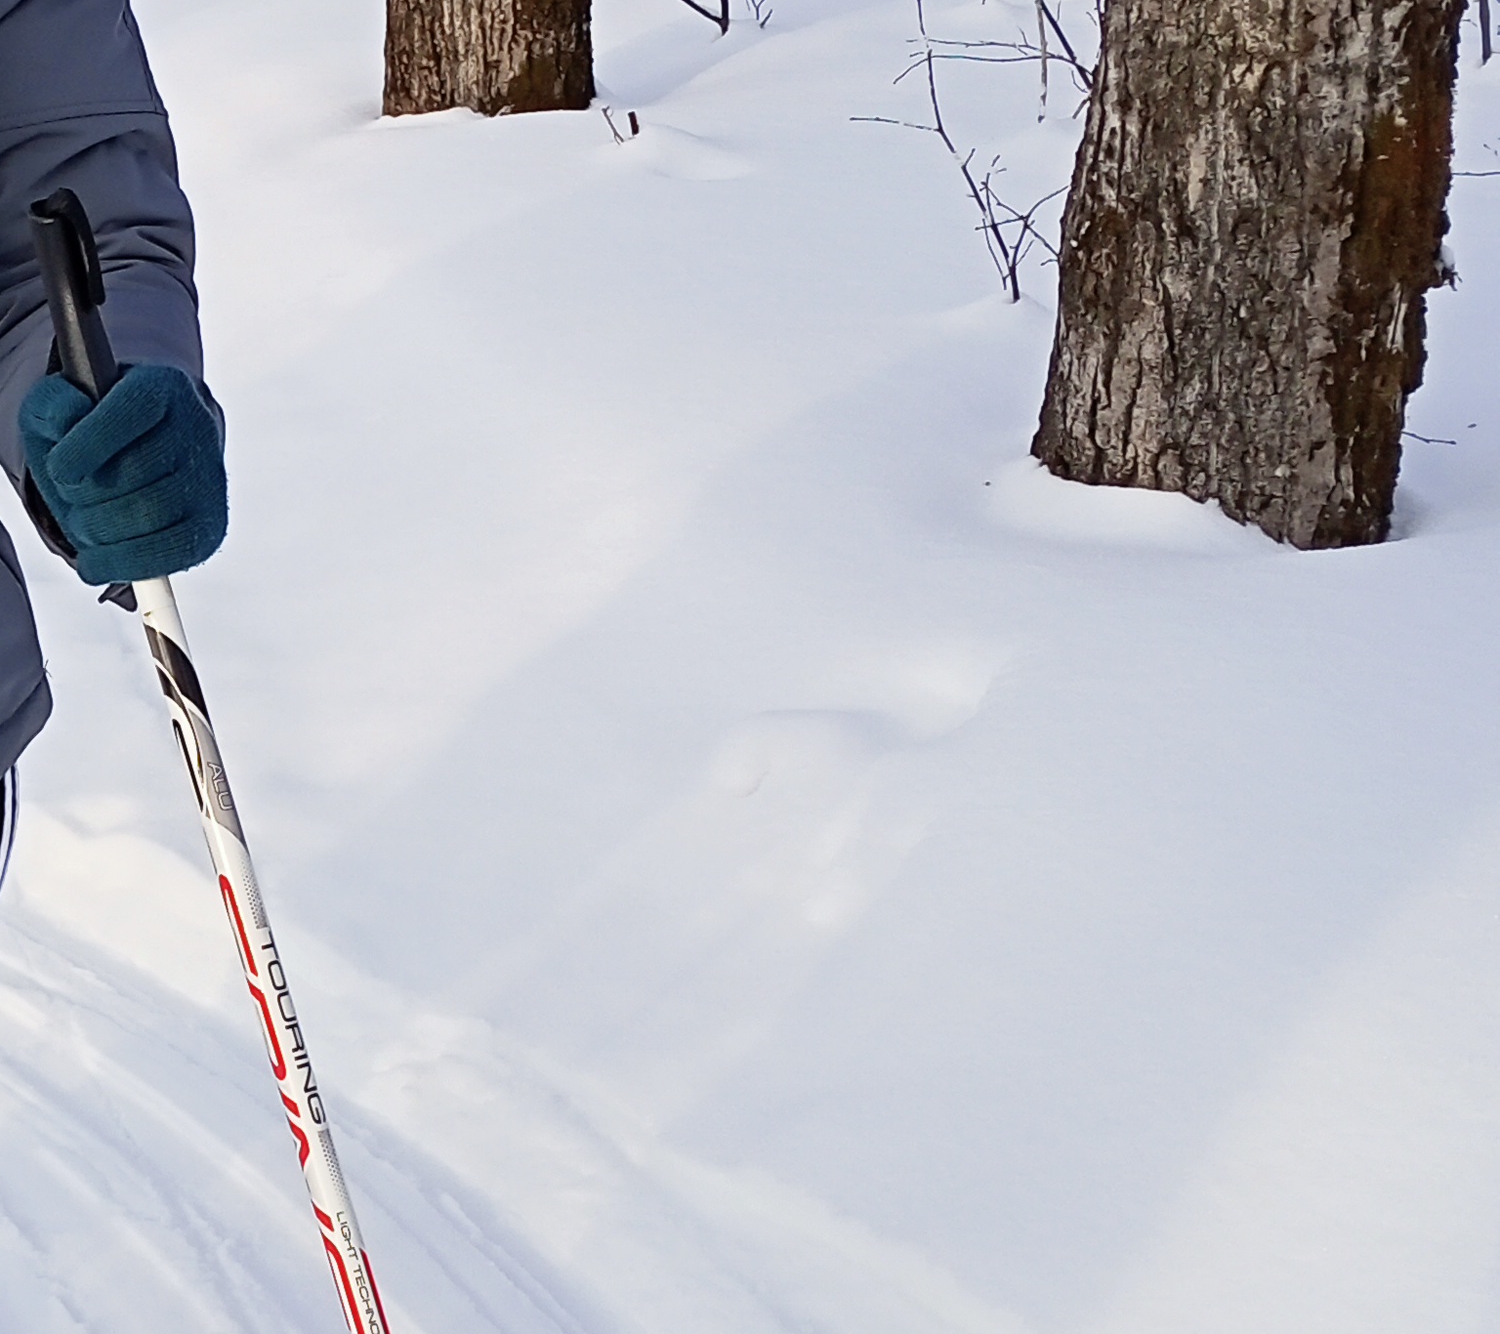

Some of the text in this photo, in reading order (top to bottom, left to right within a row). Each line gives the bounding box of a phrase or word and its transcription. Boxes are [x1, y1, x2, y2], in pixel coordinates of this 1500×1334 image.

[207, 762, 233, 811] ALU
[261, 929, 326, 1125] TOURING
[336, 1211, 359, 1261] LIGHT
